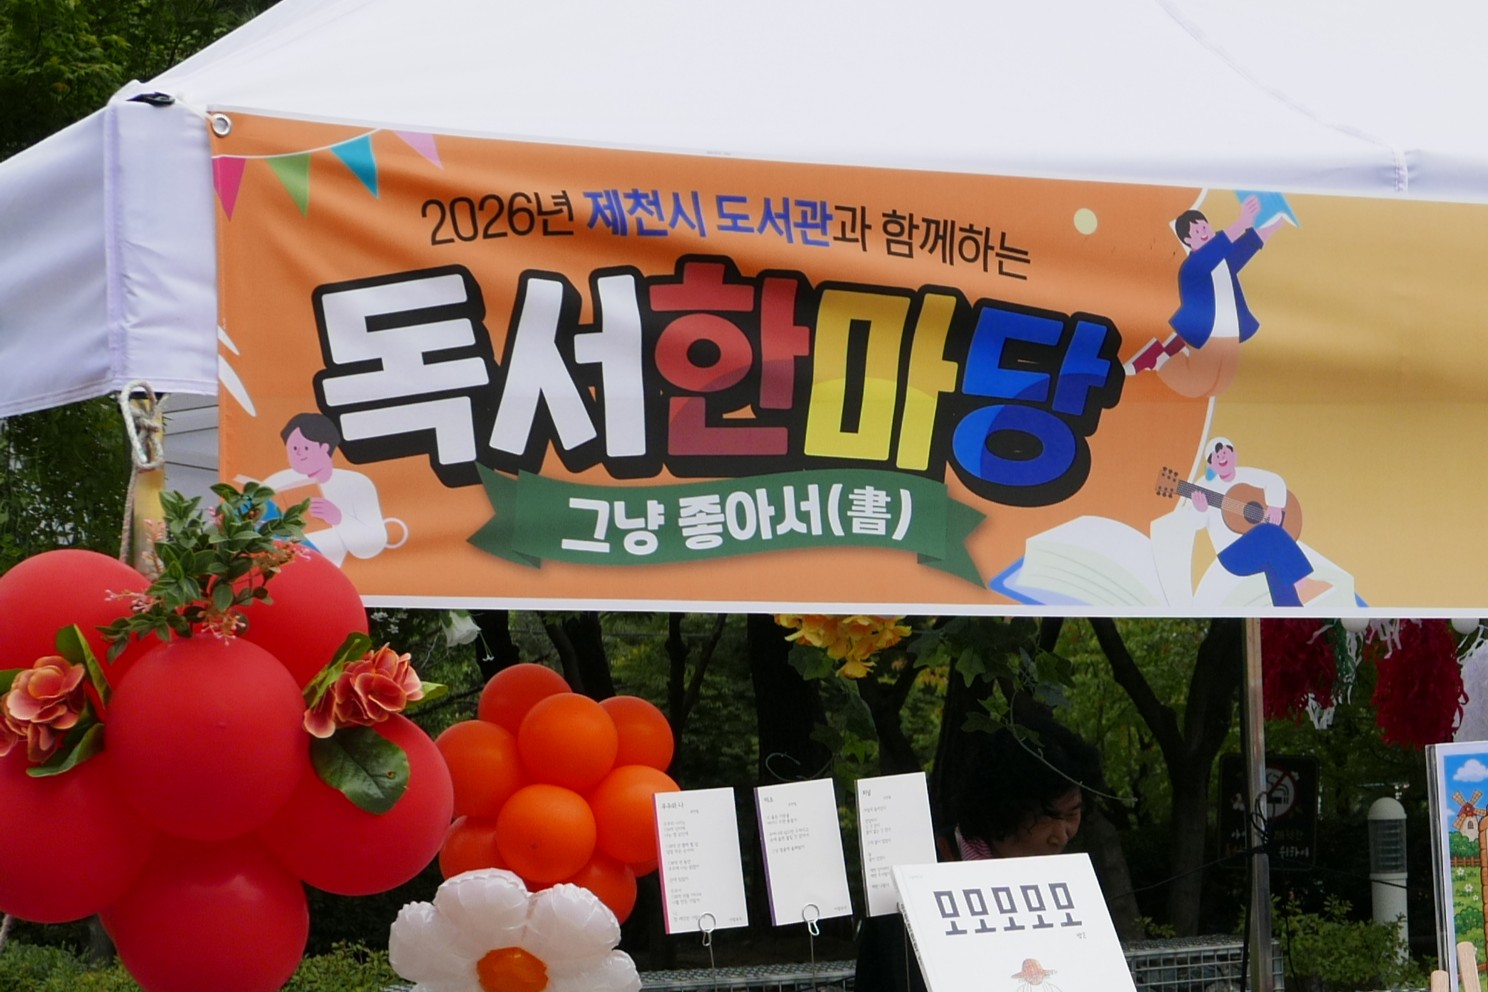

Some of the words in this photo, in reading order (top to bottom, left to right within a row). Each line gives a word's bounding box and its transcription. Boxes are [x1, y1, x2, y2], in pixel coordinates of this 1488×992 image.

[422, 190, 573, 245] 2026년
[585, 189, 709, 239] 제천시
[716, 191, 870, 253] 도서관과
[883, 208, 1032, 281] 함께하는
[317, 258, 1116, 494] 독서한마당
[561, 489, 665, 557] 그냥
[678, 481, 912, 552] 좋아서(書)
